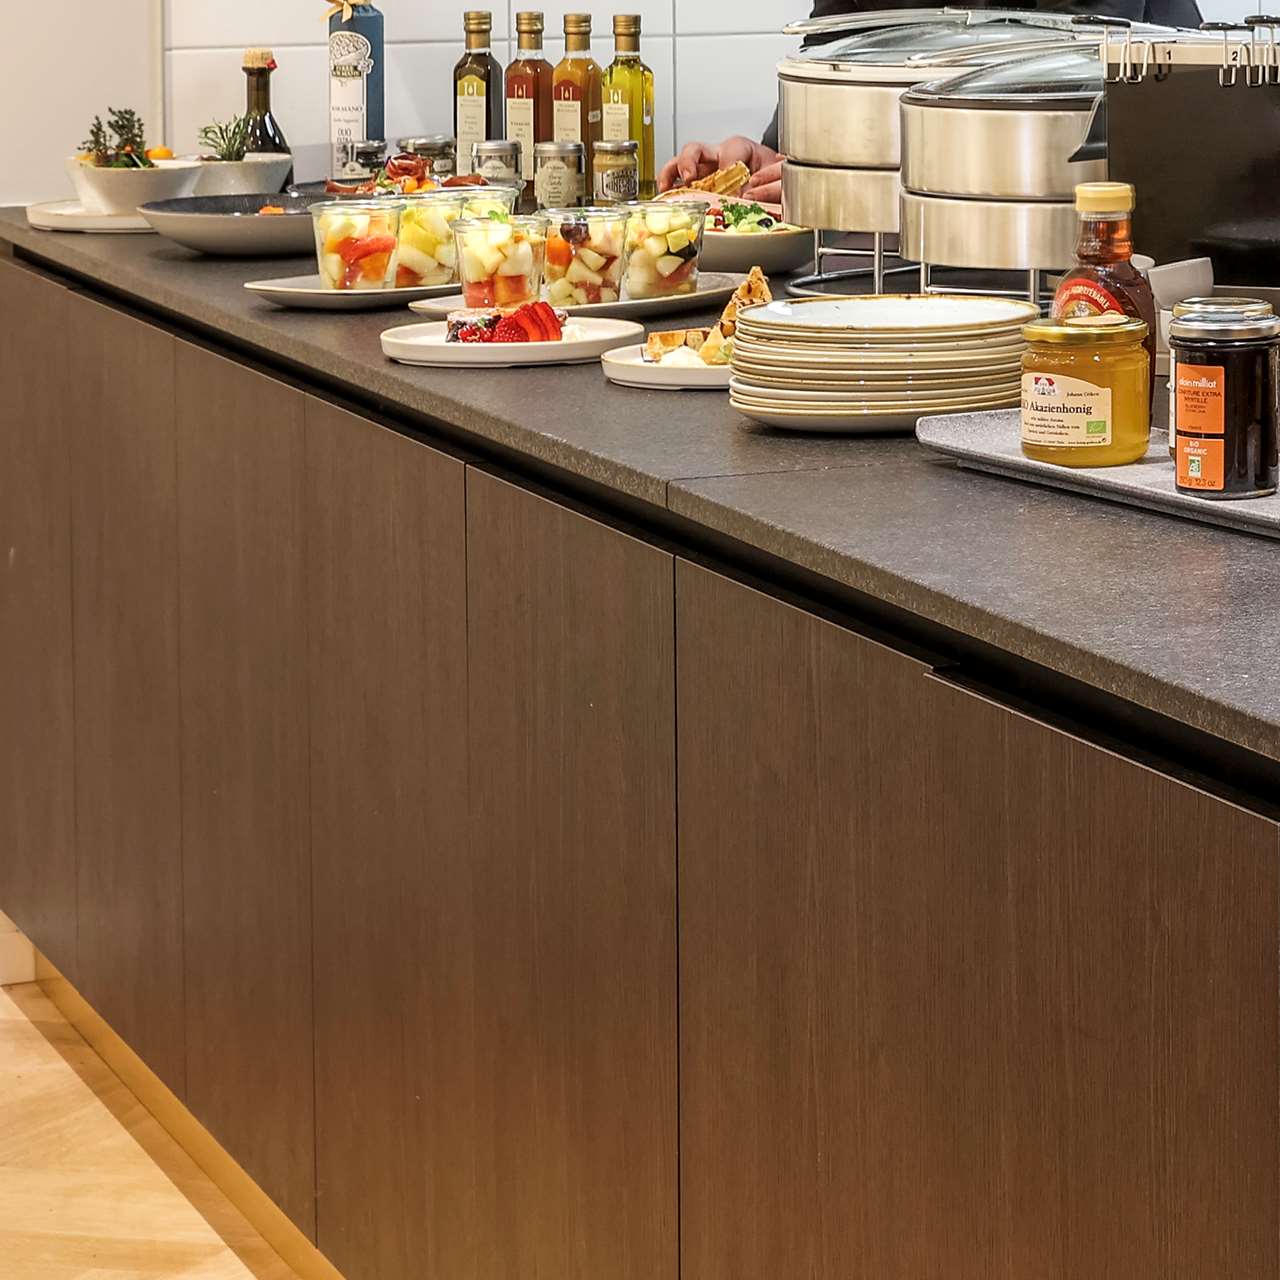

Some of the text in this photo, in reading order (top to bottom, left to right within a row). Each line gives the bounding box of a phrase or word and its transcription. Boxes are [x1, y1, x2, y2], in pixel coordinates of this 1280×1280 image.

[1166, 50, 1172, 61] 1
[1231, 51, 1239, 61] 2
[1029, 401, 1093, 416] Akazienhonig
